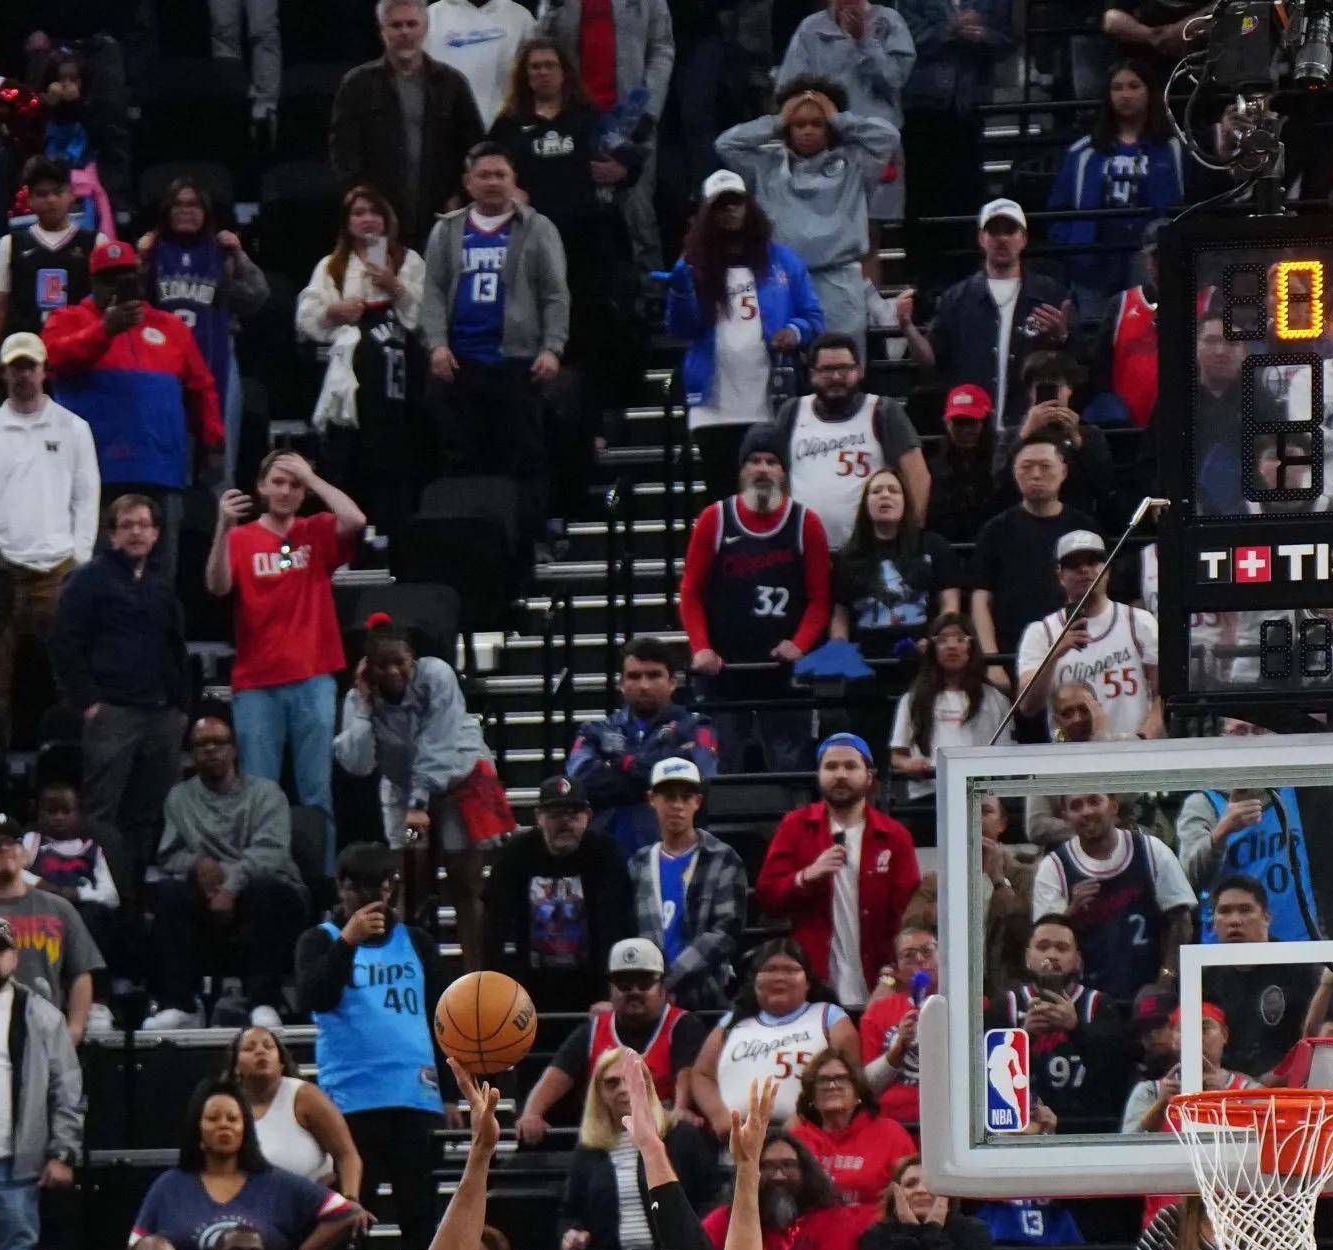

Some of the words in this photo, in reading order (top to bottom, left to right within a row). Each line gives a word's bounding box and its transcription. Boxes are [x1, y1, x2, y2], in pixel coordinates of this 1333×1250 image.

[473, 272, 498, 303] 13
[797, 432, 868, 464] Clippers
[835, 451, 872, 479] 55
[753, 584, 790, 618] 32
[1103, 668, 1138, 699] 55
[1127, 913, 1148, 947] 2
[349, 962, 417, 989] Clips
[382, 986, 418, 1016] 40
[730, 1028, 810, 1065] Clippers
[1047, 1054, 1089, 1090] 97
[990, 1107, 1013, 1126] NBA
[1019, 1209, 1045, 1238] 13
